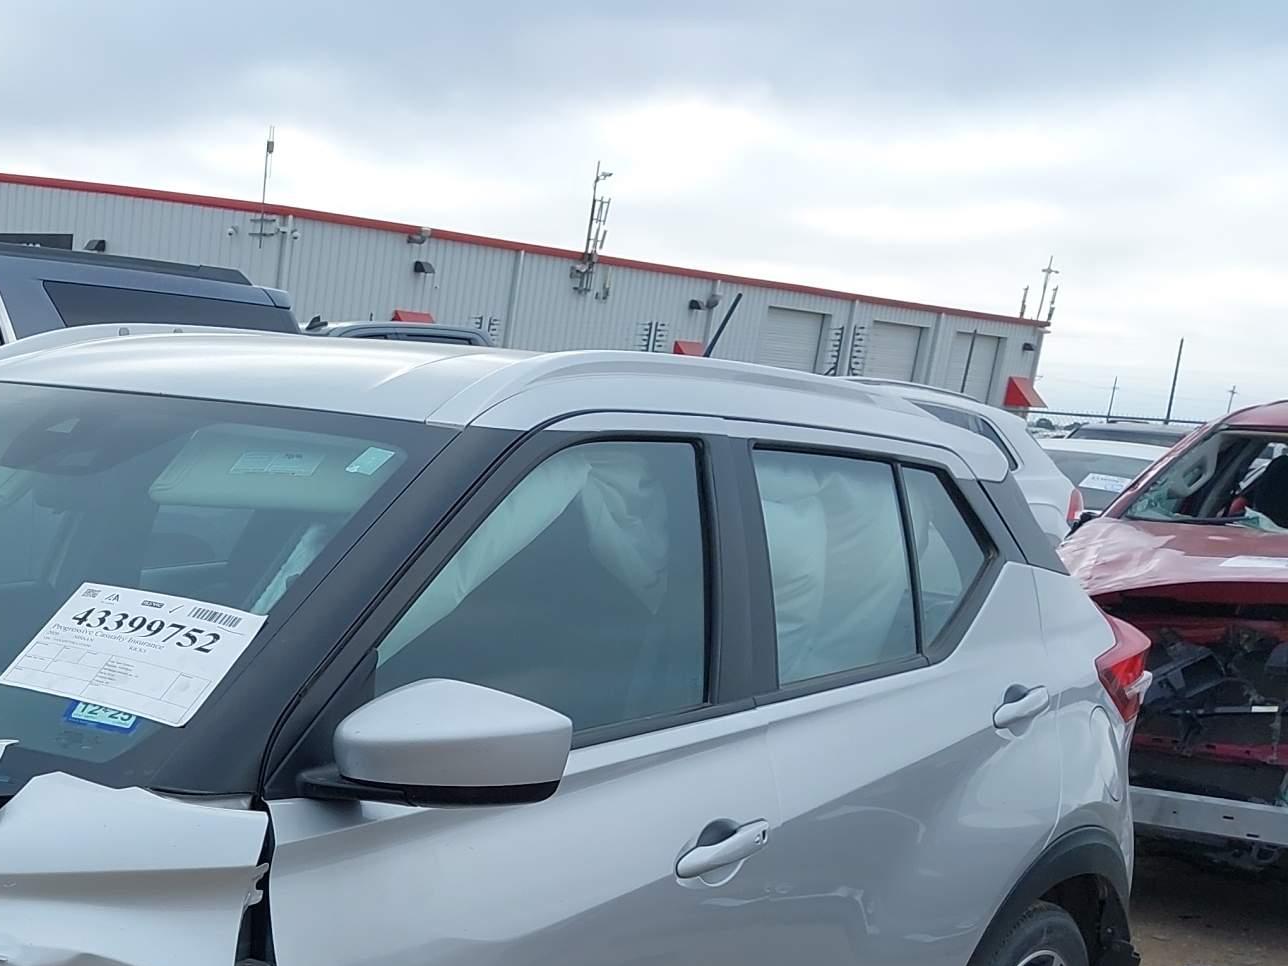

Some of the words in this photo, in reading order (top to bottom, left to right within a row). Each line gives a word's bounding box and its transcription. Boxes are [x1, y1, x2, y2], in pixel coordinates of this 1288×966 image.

[51, 623, 96, 636] Progressive
[94, 630, 127, 644] Casualty
[127, 637, 166, 650] Insurance
[71, 607, 221, 653] 43399752
